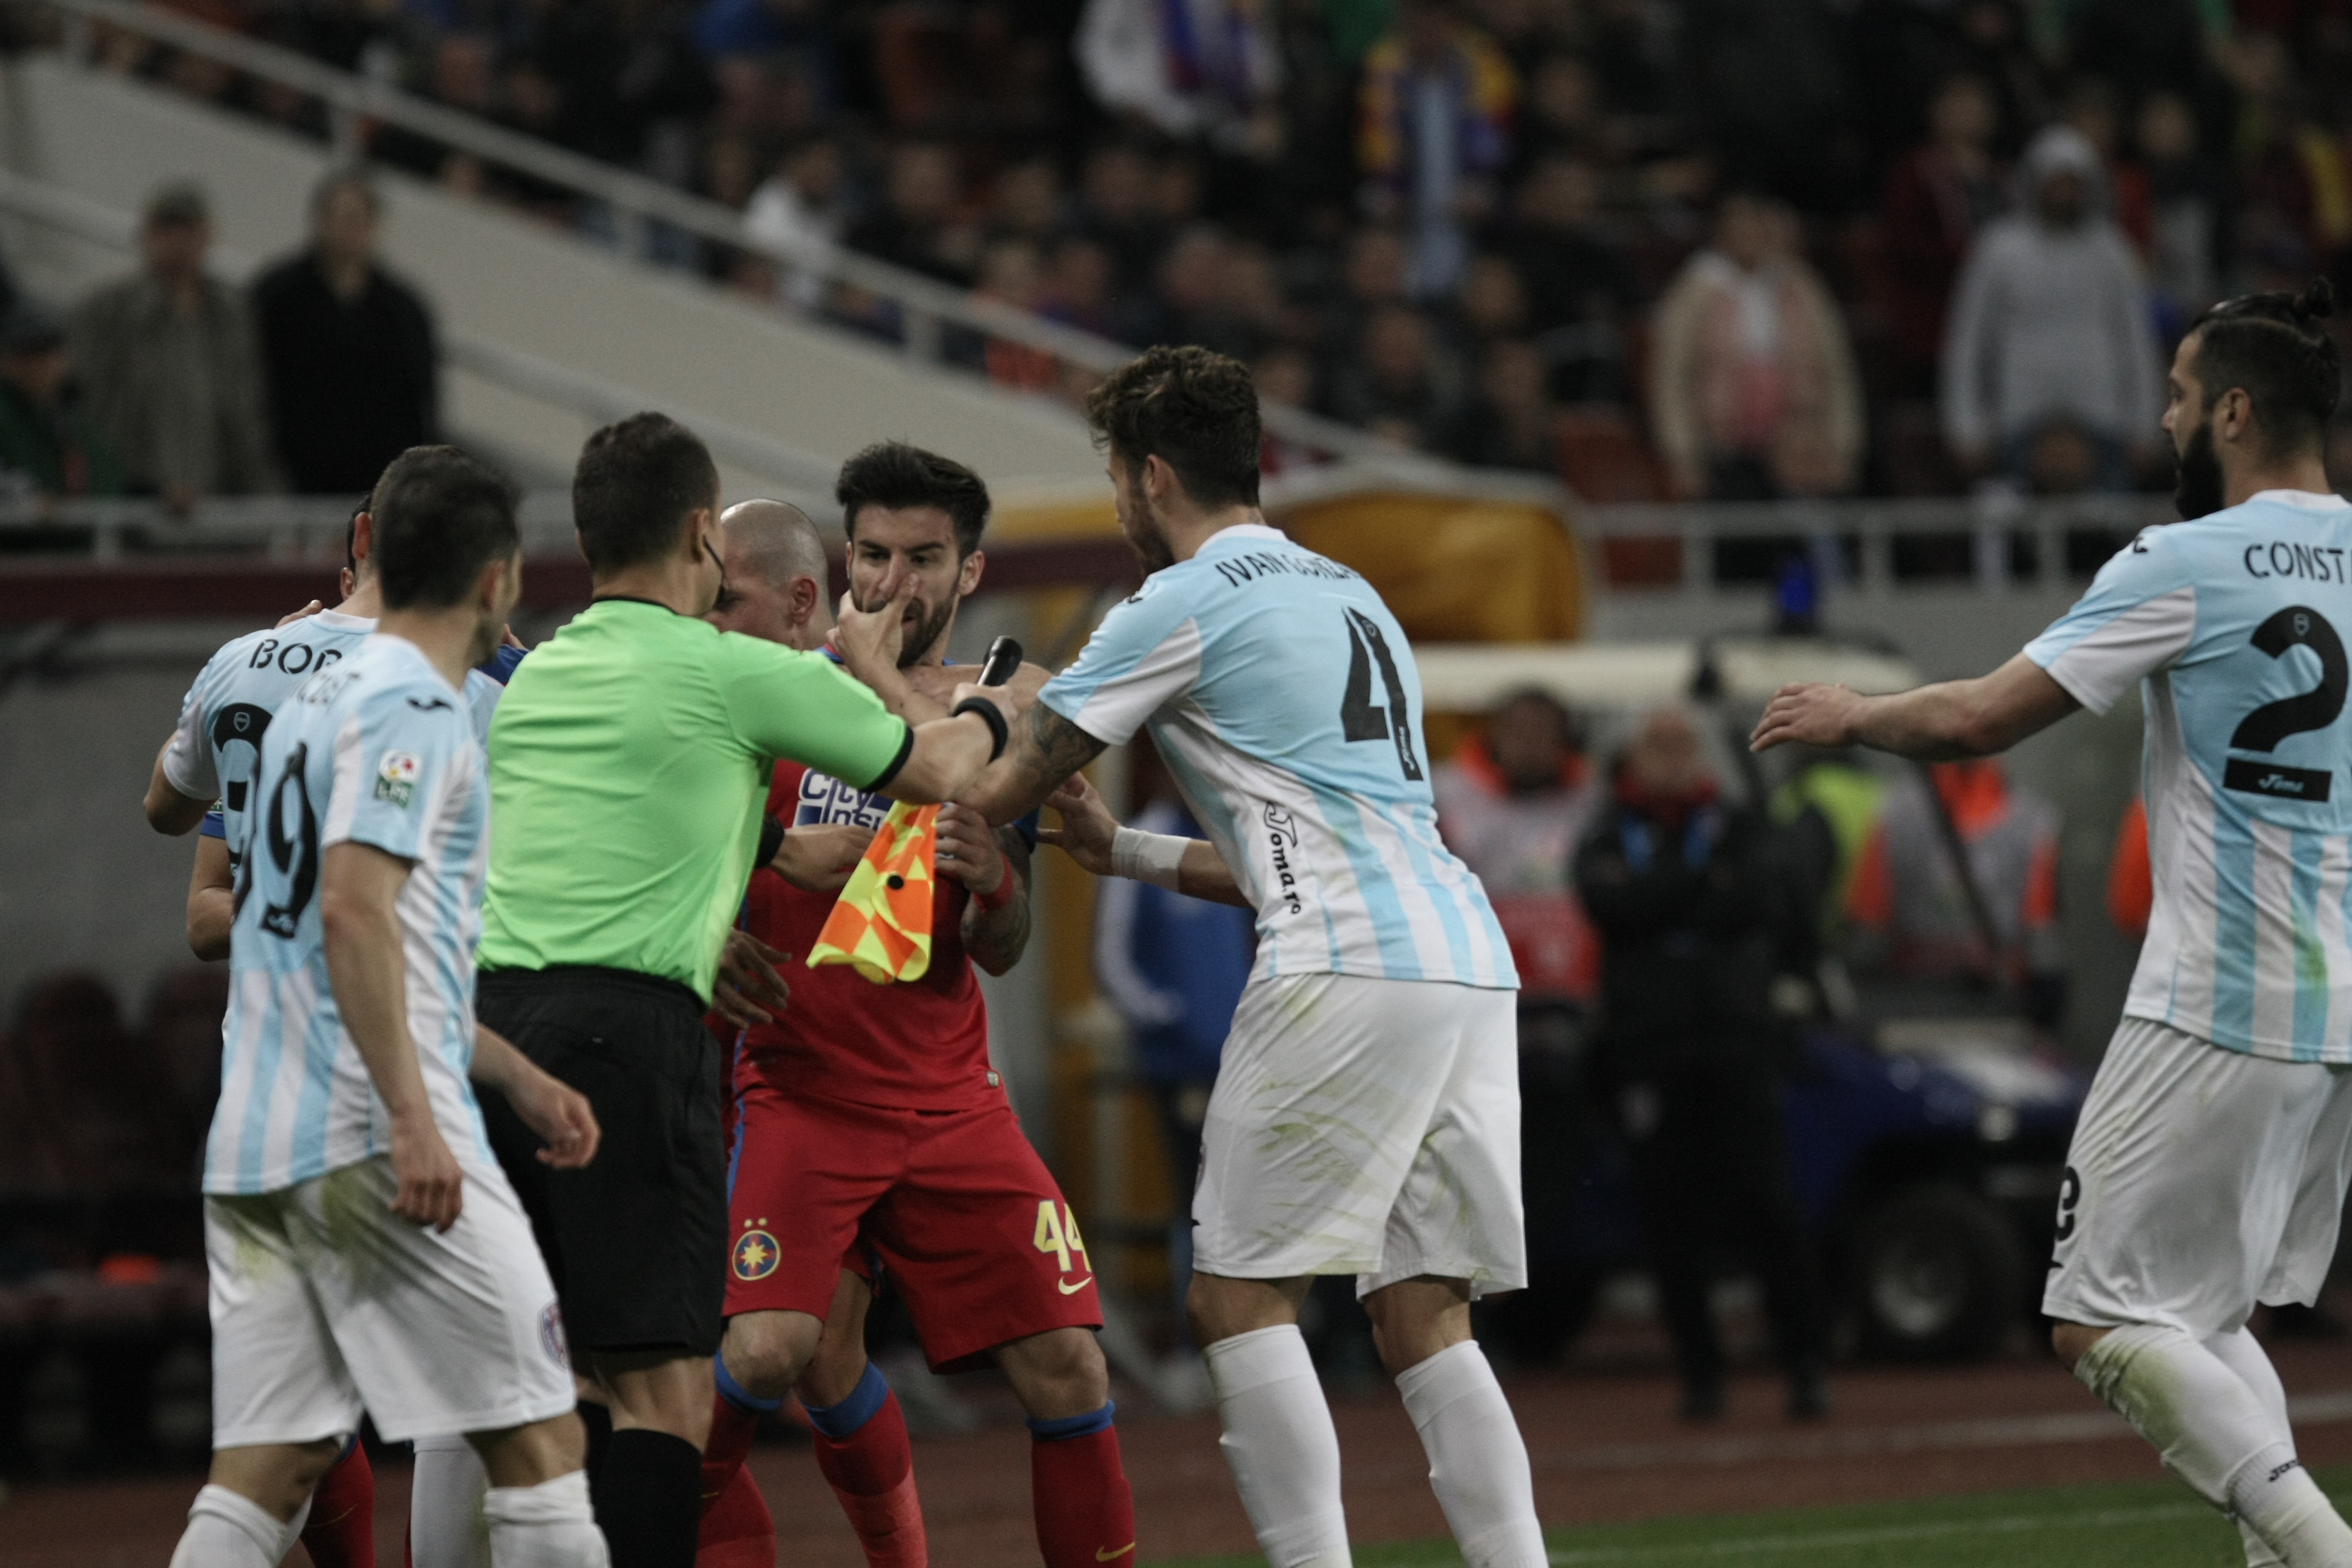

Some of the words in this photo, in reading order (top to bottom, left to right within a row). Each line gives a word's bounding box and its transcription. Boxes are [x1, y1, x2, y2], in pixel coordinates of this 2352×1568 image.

[1214, 552, 1290, 587] IVAN
[2244, 541, 2352, 585] CONST
[1339, 606, 1424, 781] 4
[2223, 604, 2352, 803] 2
[1033, 1198, 1093, 1273] 44
